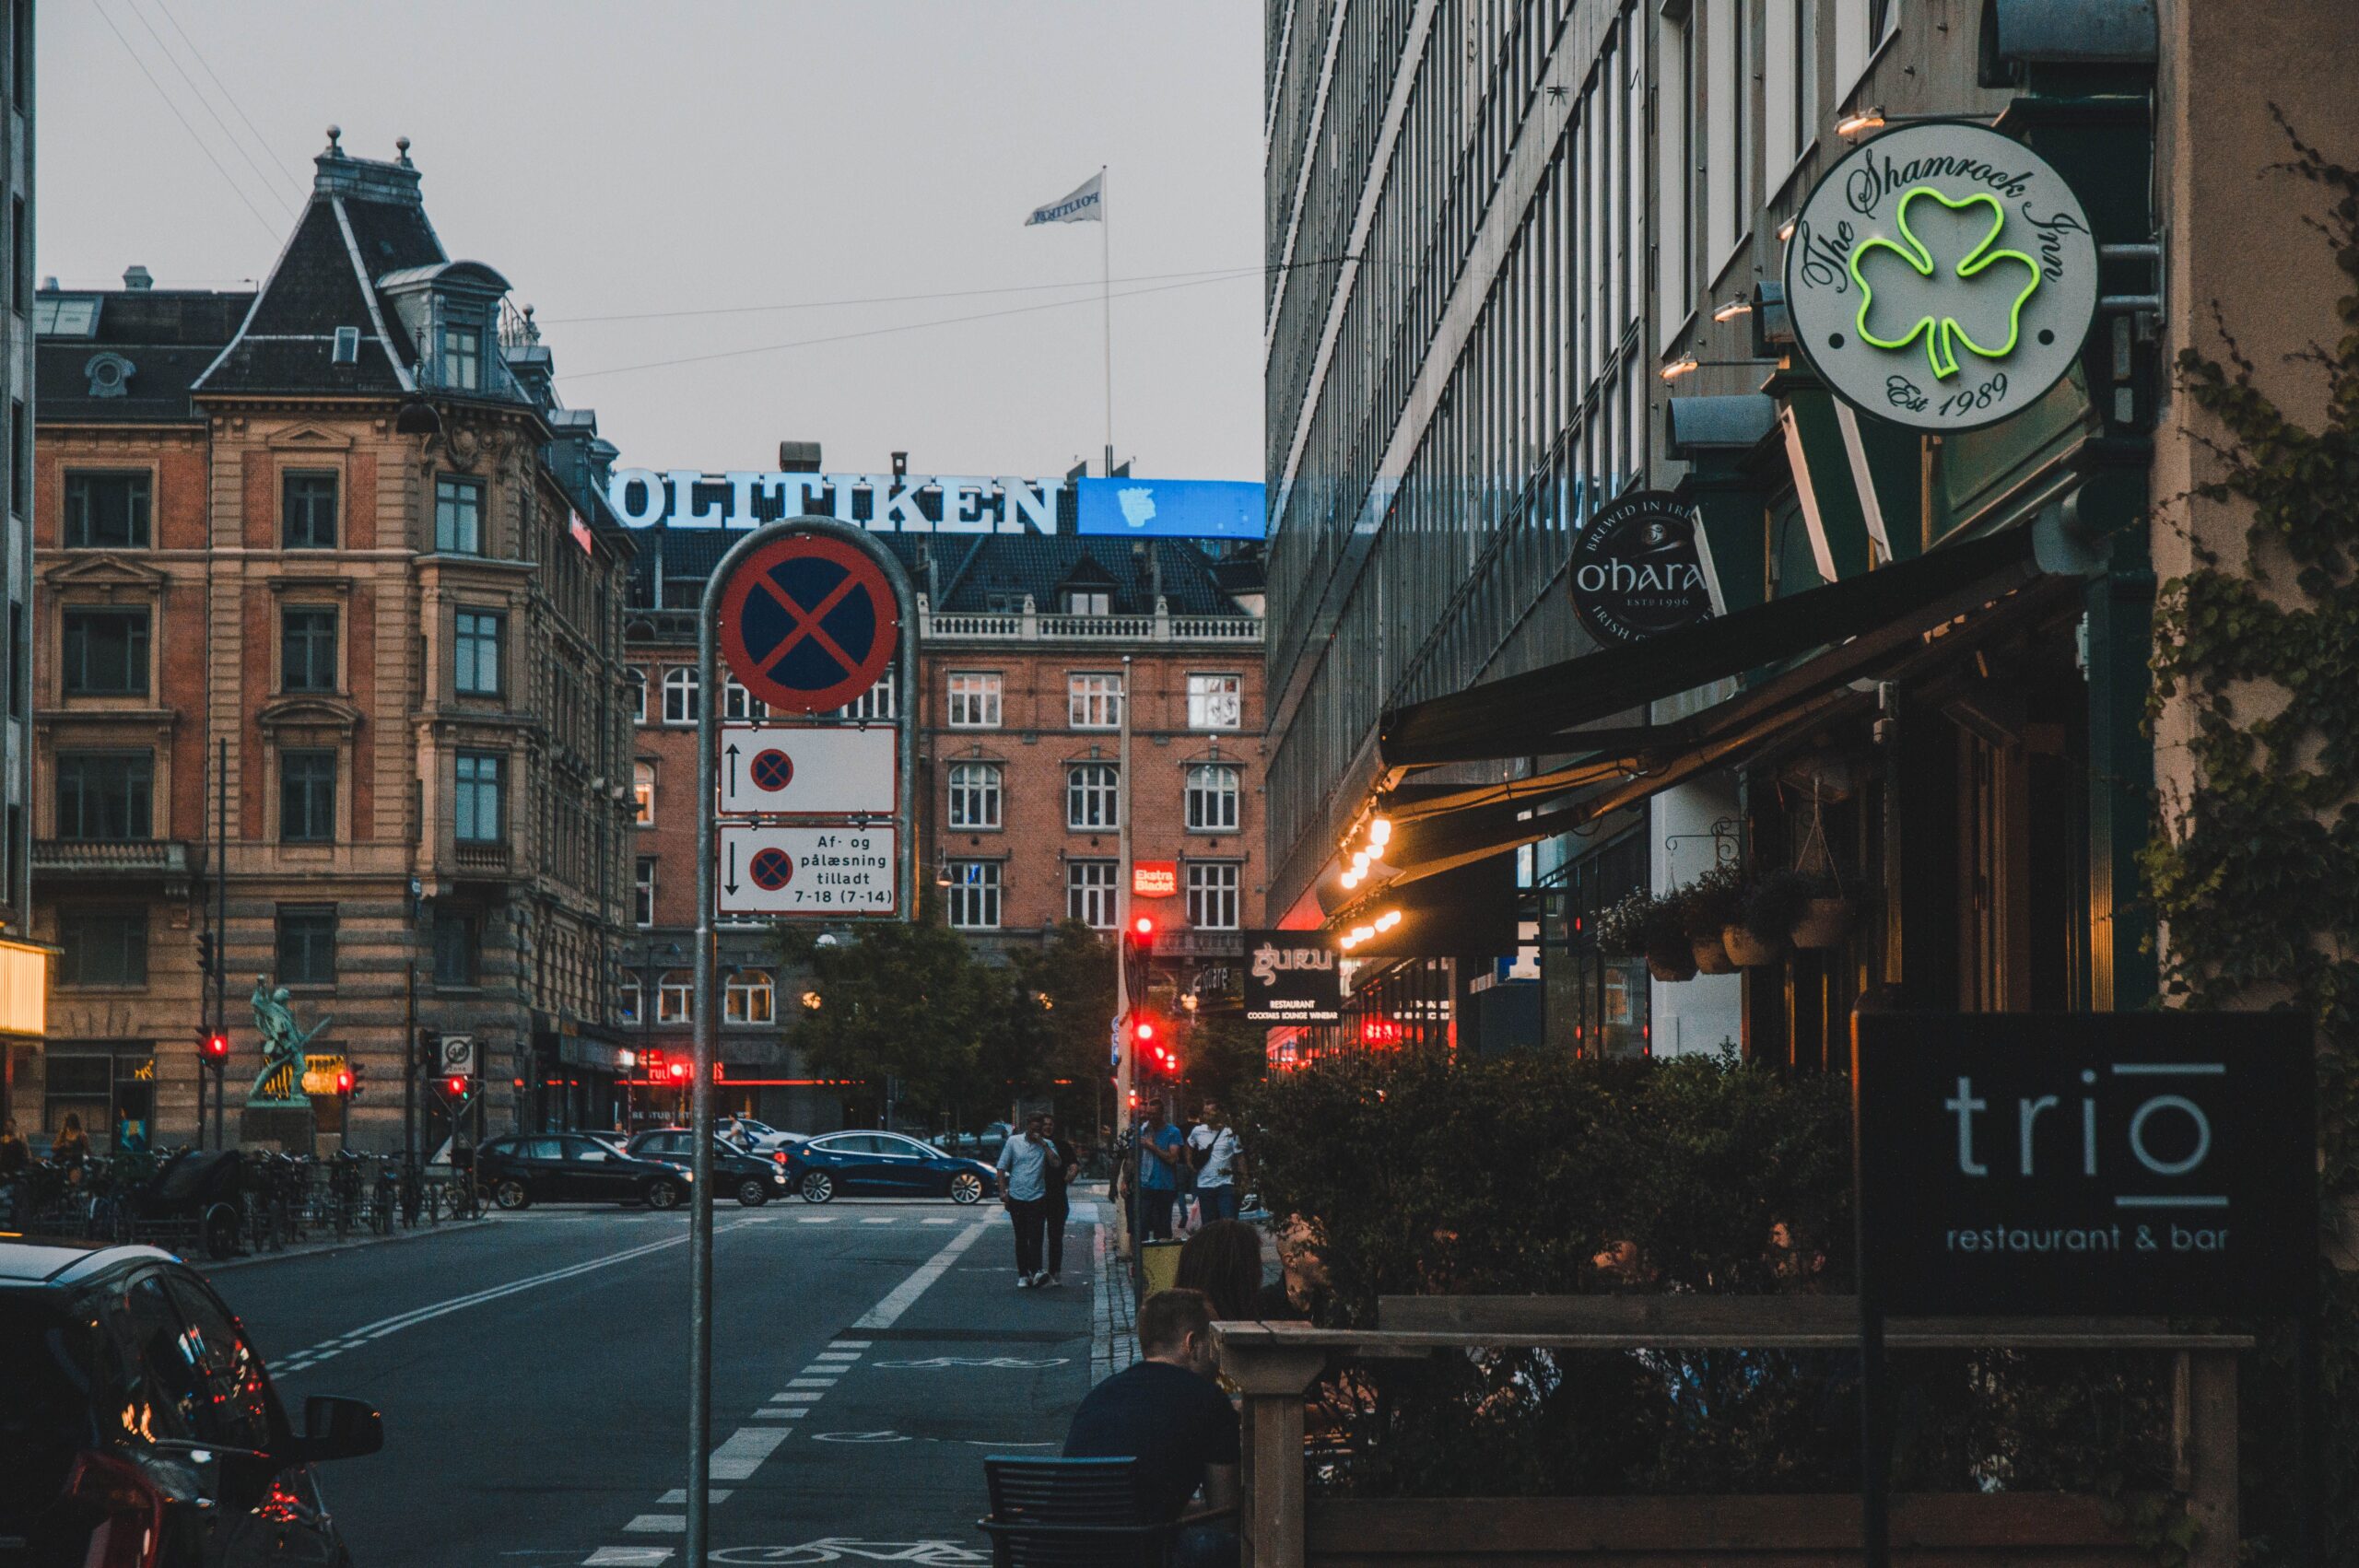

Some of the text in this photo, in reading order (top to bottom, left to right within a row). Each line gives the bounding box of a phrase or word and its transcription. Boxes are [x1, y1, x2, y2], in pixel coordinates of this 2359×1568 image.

[1802, 148, 2090, 293] The Shamrock Inn
[1886, 372, 2008, 416] Est 1989
[1586, 504, 1636, 551] BREWED
[1643, 500, 1661, 511] IN
[1659, 598, 1689, 608] 1996
[1592, 605, 1629, 639] IRISH
[817, 836, 870, 850] Af- og
[801, 853, 886, 869] pålæsning
[816, 872, 870, 884] tilladt
[1135, 870, 1173, 881] Ekstra
[1135, 880, 1174, 891] Bladet
[794, 890, 892, 904] 7-18 (7-14)
[1270, 1000, 1315, 1009] RESTAURANT
[1247, 1012, 1338, 1020] COCKTAILS LOUNGE WINEBAR
[1944, 1069, 2211, 1176] trio
[1946, 1223, 2229, 1251] restaurant & bar
